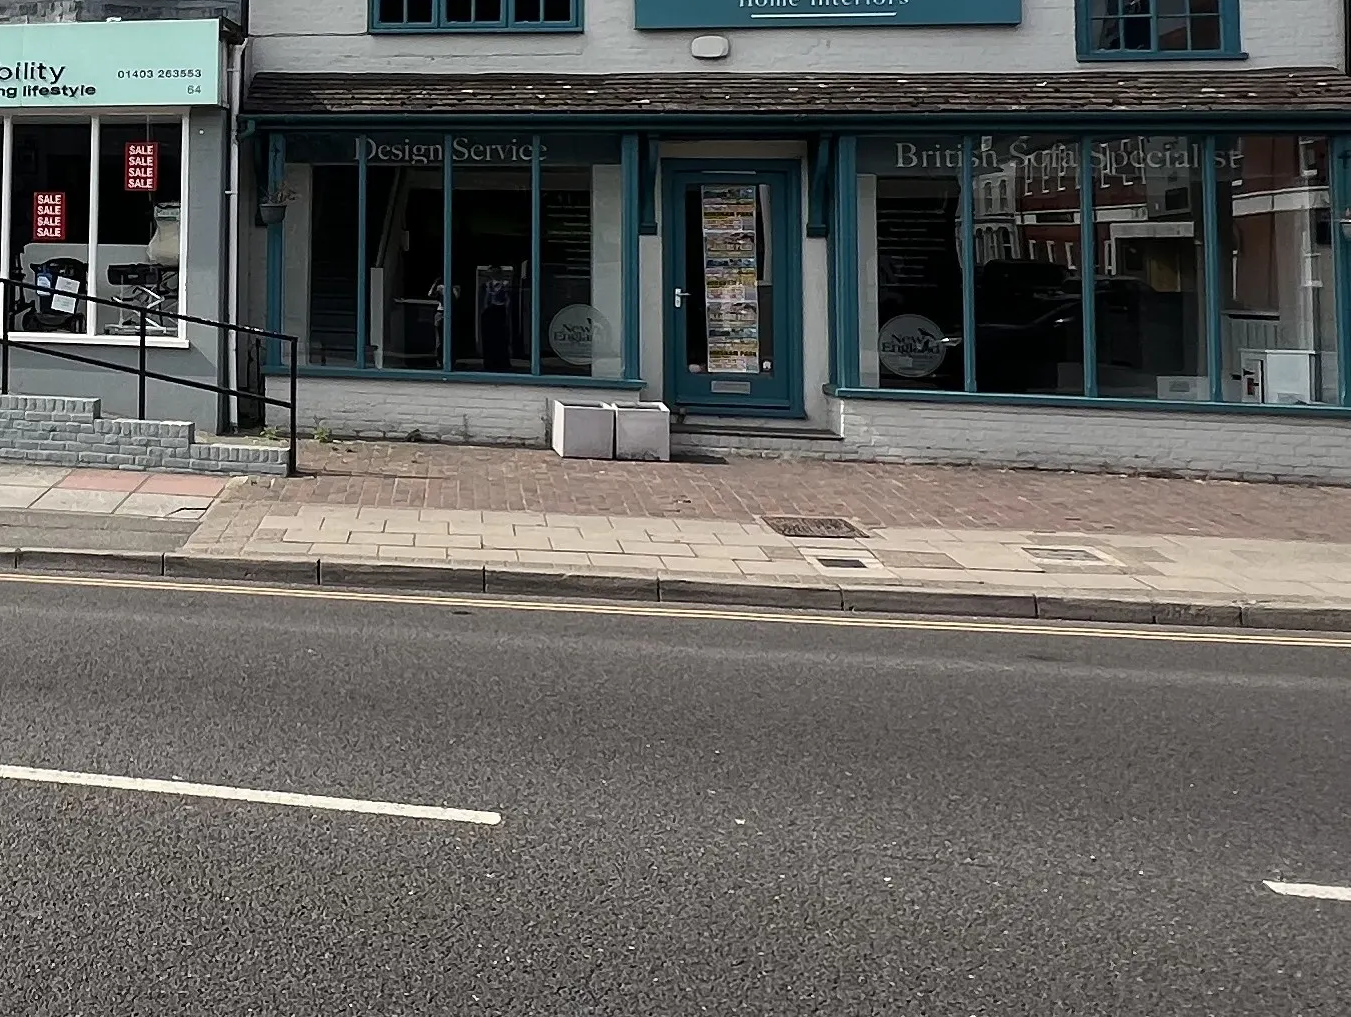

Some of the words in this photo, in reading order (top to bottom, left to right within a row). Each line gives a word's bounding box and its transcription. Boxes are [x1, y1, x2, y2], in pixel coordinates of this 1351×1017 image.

[117, 70, 154, 79] 01403
[157, 69, 202, 78] 263553
[22, 84, 97, 99] lifestyle
[187, 85, 202, 94] 64
[129, 145, 154, 155] SALE
[354, 137, 444, 165] Design
[129, 156, 154, 166] SALE
[895, 141, 999, 168] British
[1089, 141, 1243, 175] Specialst
[129, 167, 154, 177] SALE
[129, 178, 154, 188] SALE
[37, 194, 62, 204] SALE
[37, 205, 62, 215] SALE
[37, 216, 62, 226] SALE
[37, 227, 62, 237] SALE
